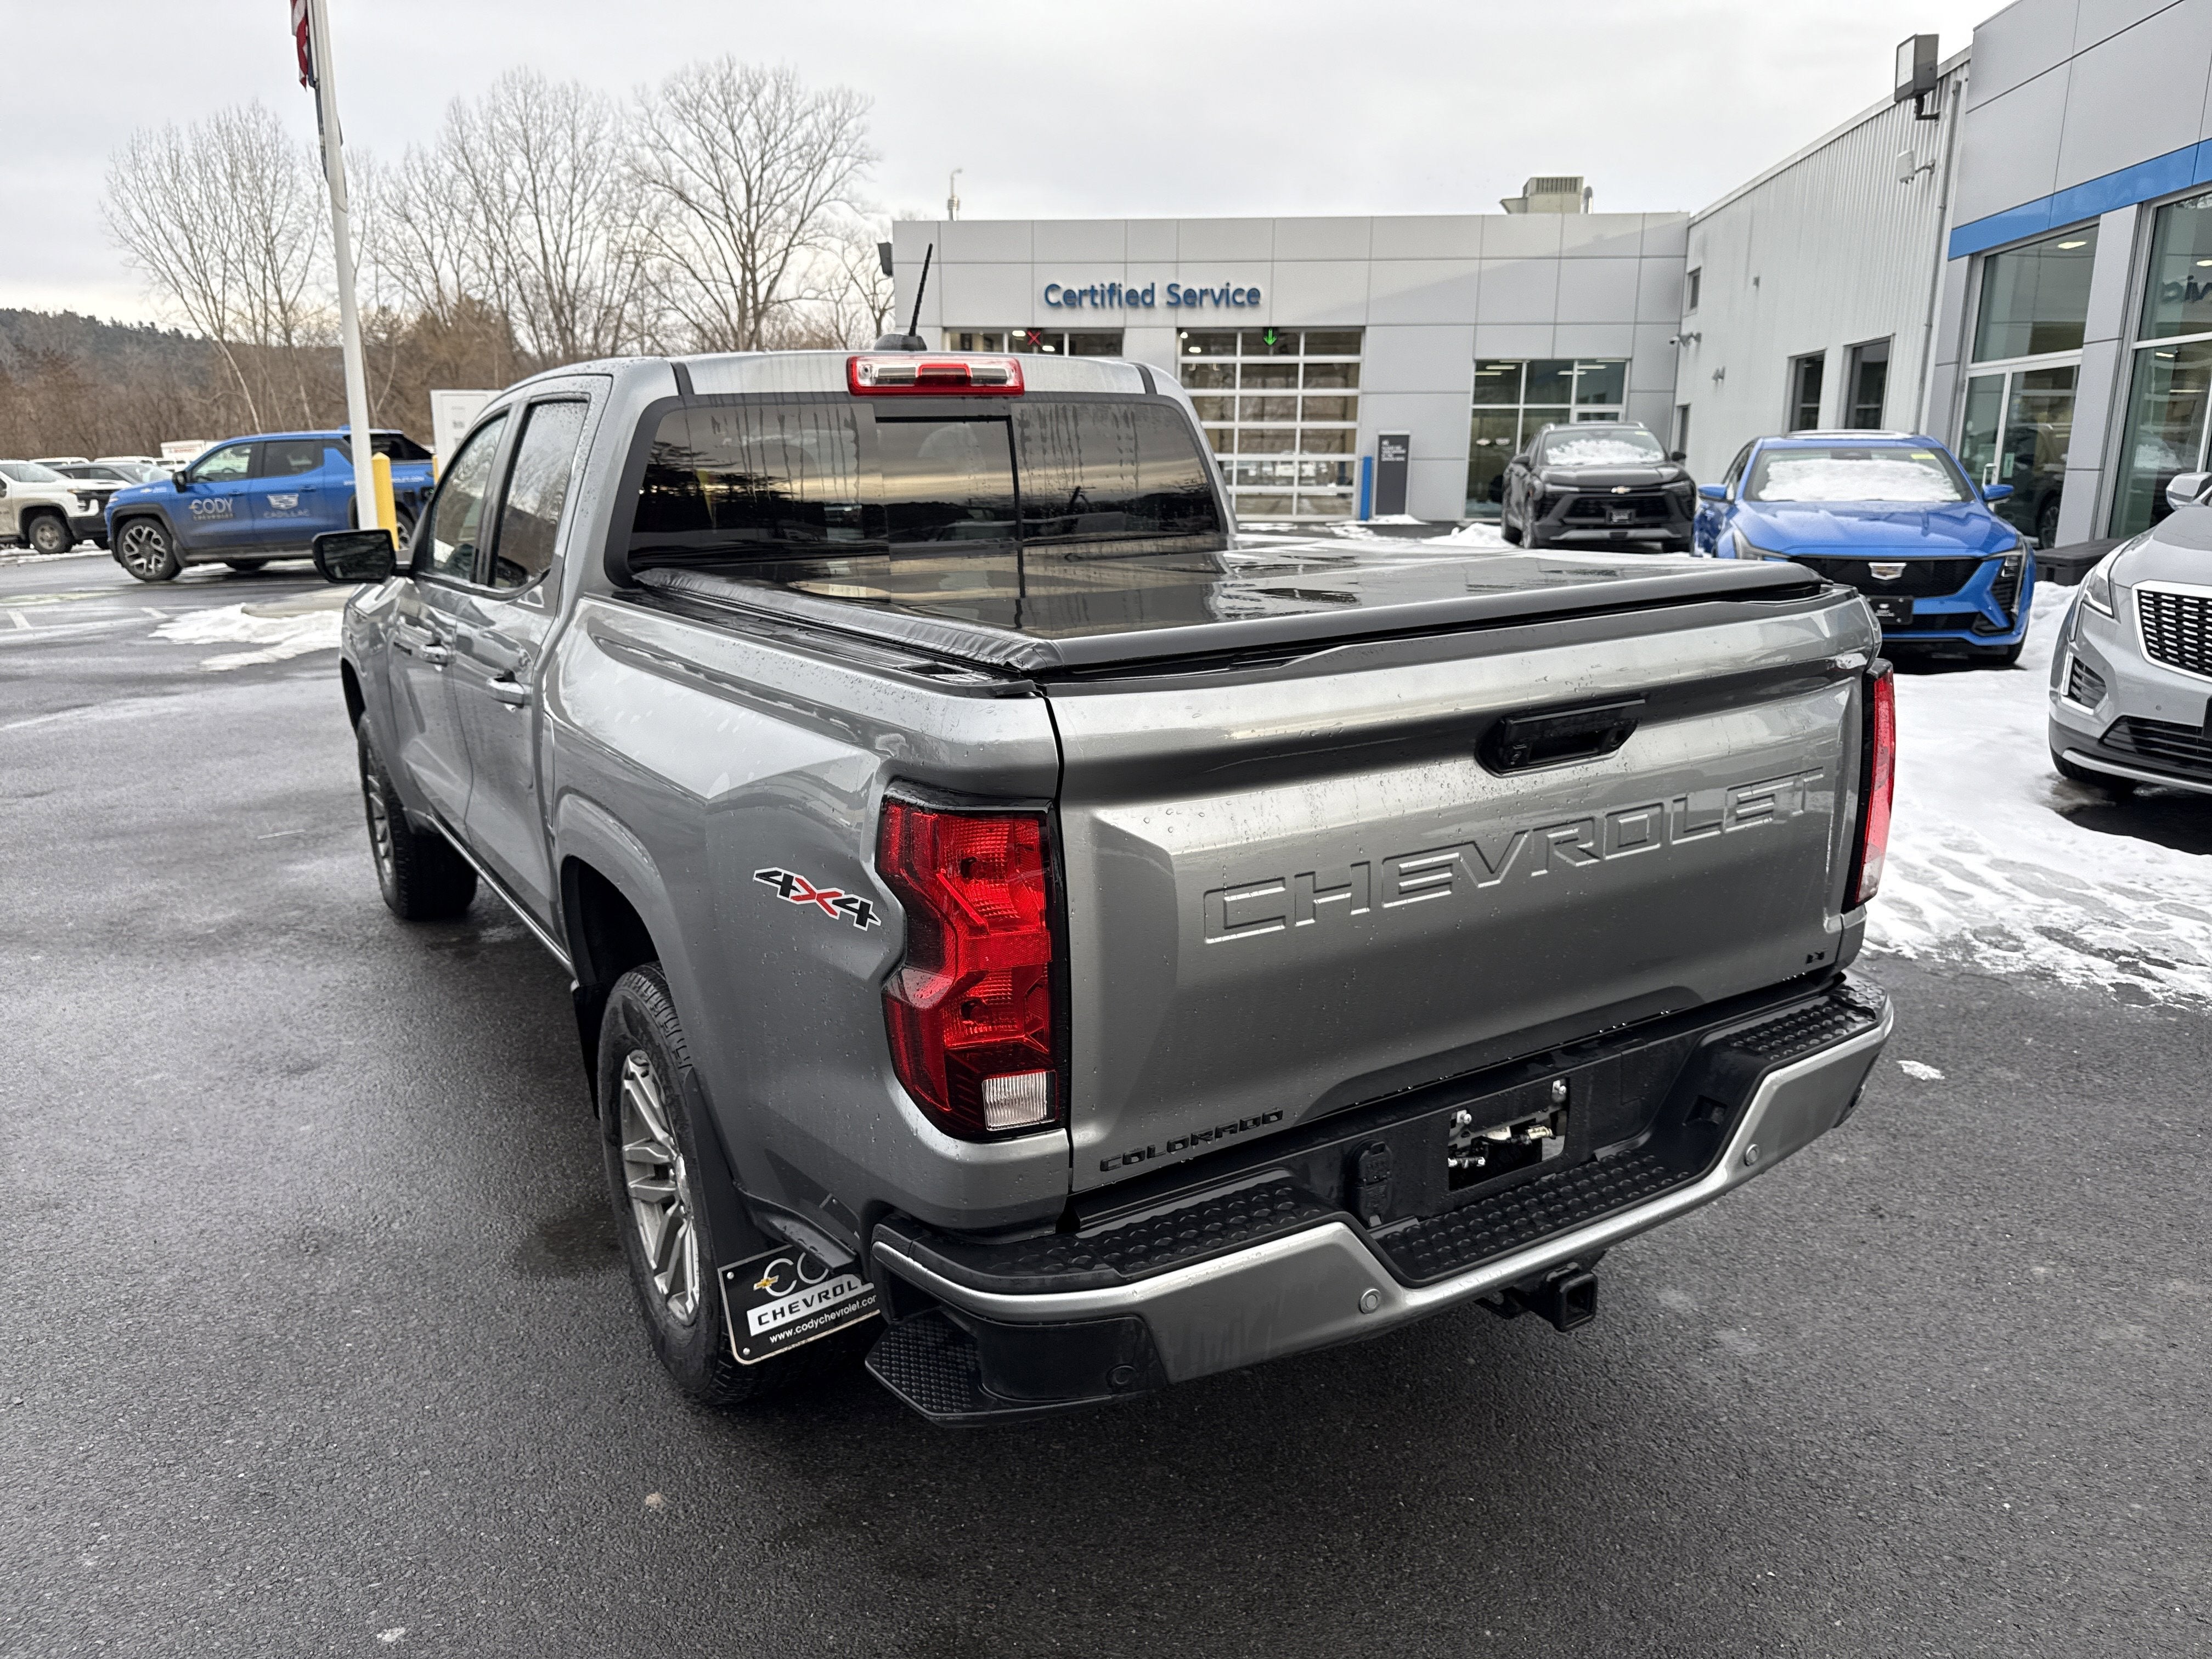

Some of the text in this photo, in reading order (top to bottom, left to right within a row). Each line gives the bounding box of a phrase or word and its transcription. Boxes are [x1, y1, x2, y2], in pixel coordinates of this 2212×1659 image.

[1045, 282, 1261, 308] Certified Service
[191, 497, 233, 515] CODY
[1204, 767, 1824, 944] CHEVROLET
[1100, 1110, 1283, 1172] COLORADO
[763, 1252, 830, 1297] CO
[757, 1279, 858, 1326] CHEVROL
